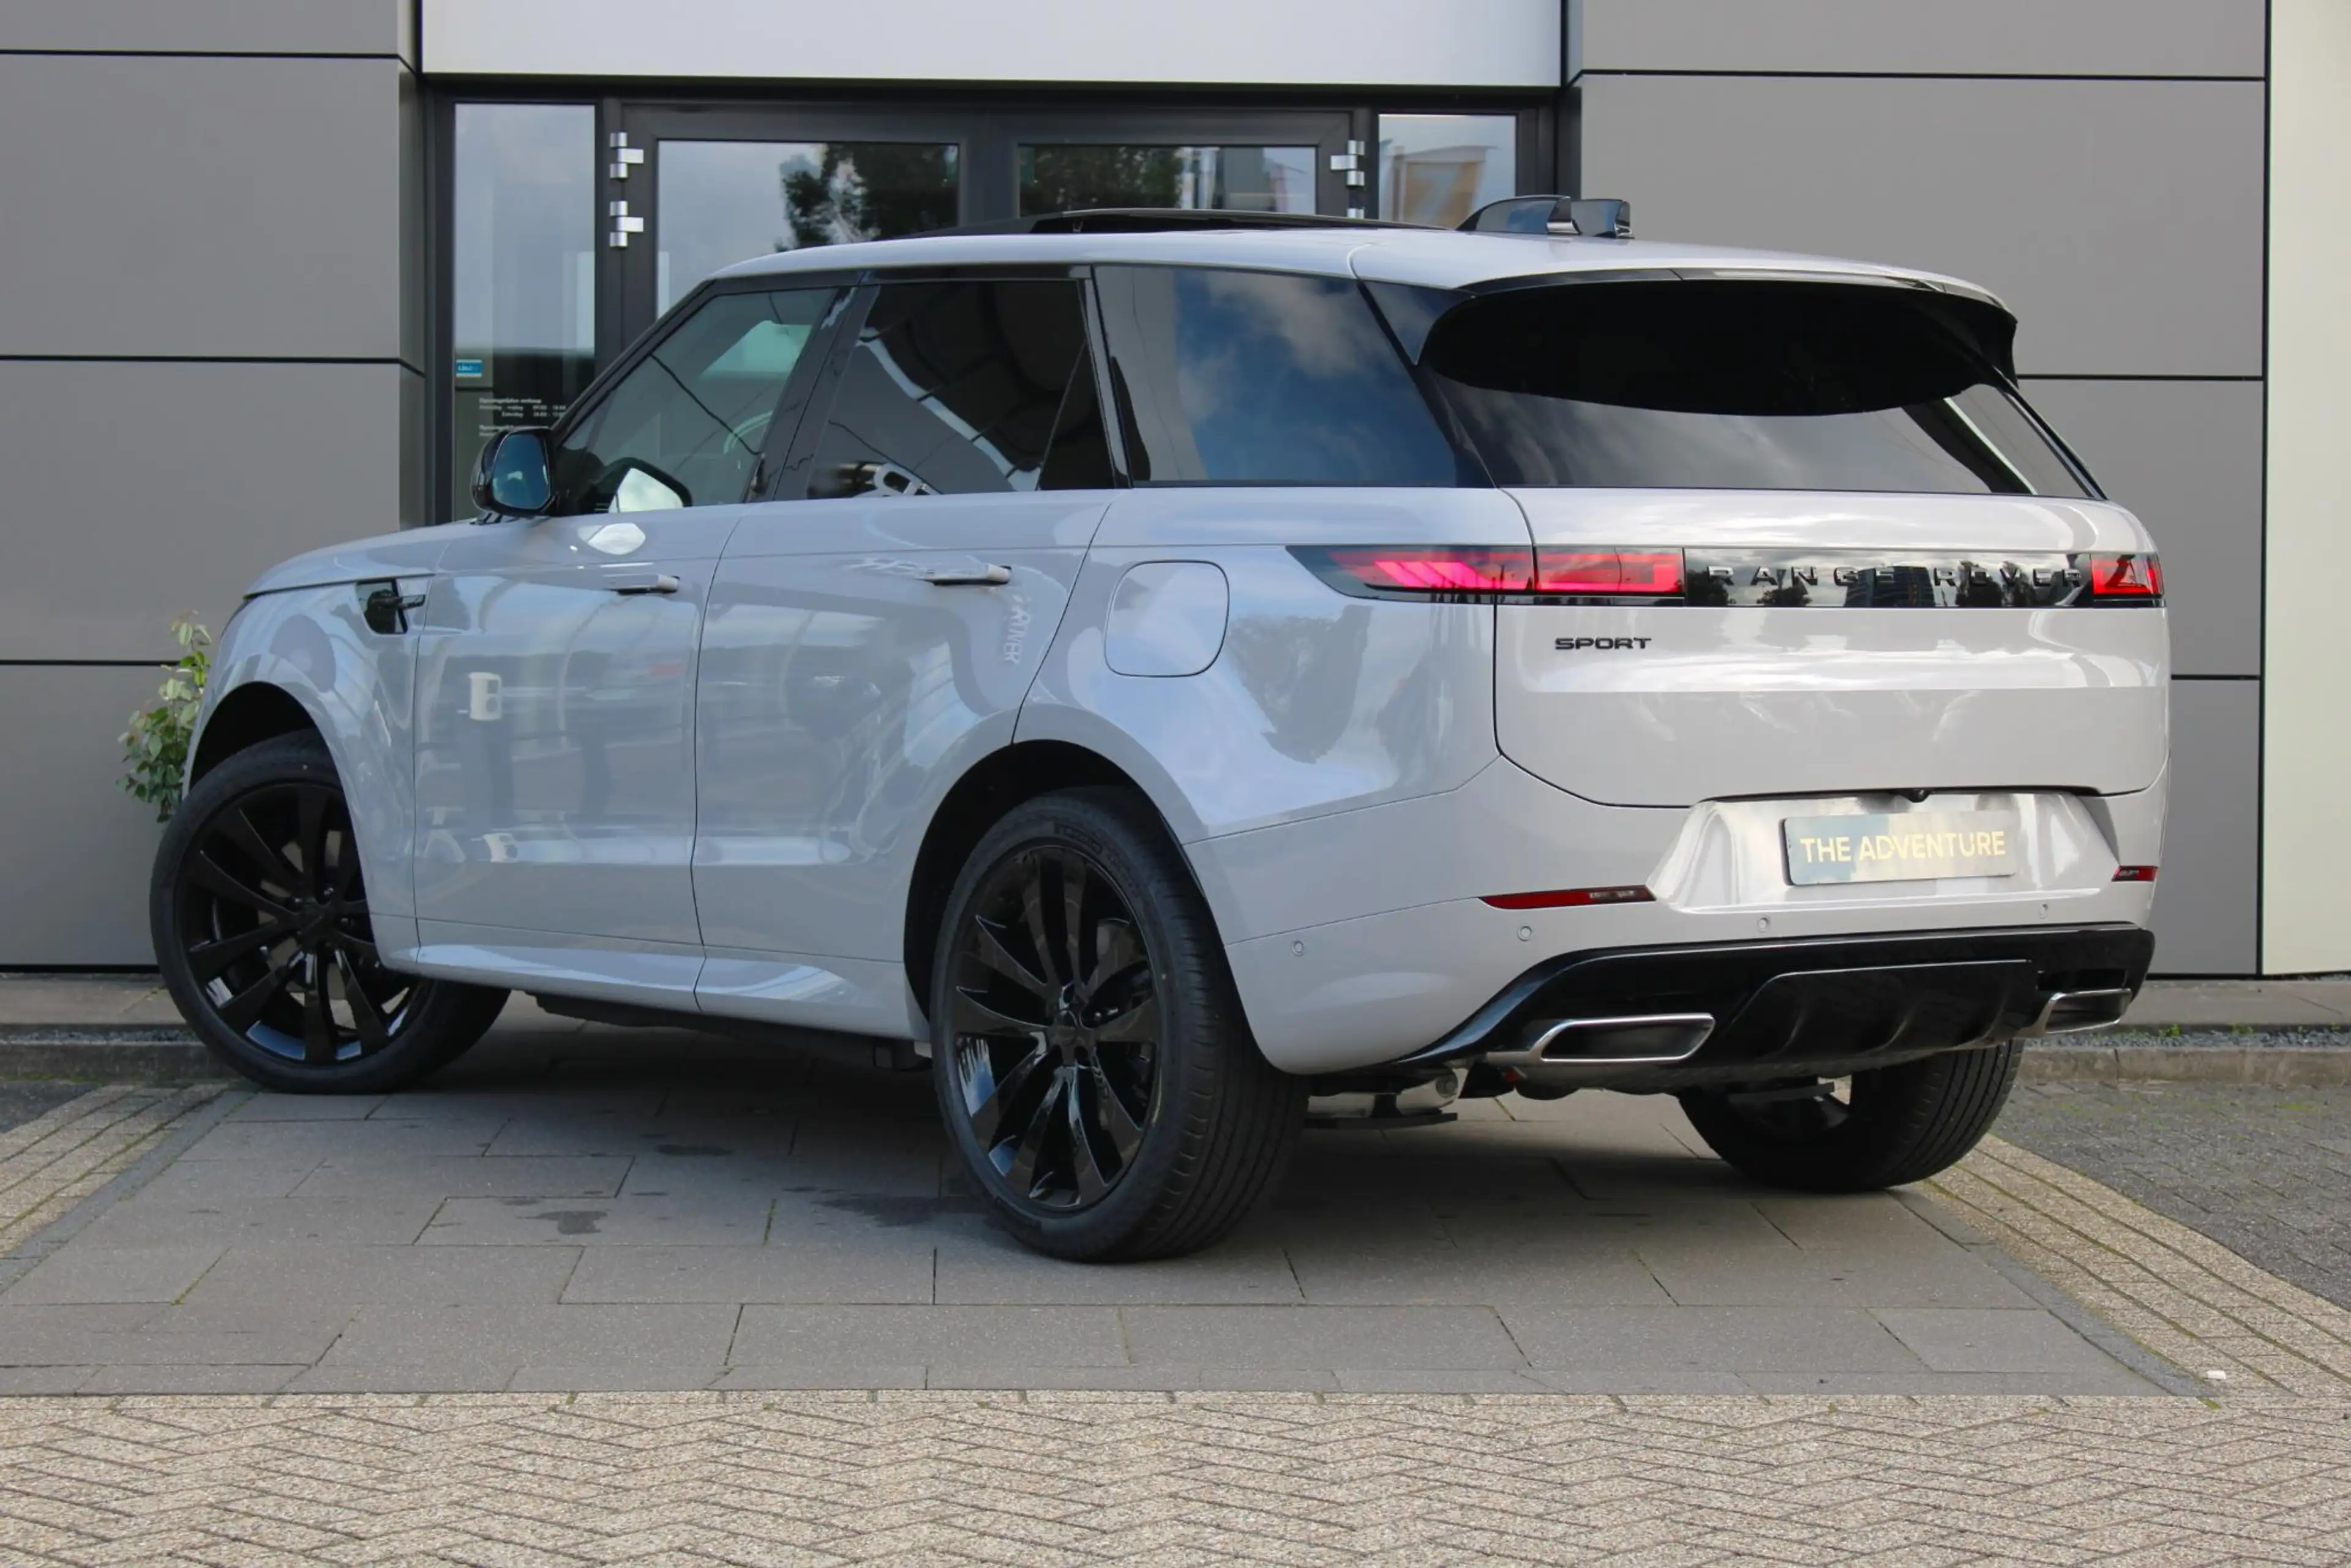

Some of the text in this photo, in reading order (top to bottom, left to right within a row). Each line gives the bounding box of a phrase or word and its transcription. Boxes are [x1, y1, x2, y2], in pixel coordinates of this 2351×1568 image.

[1706, 565, 2081, 587] RANGE ROVER
[1554, 637, 1652, 650] SPORT
[1800, 830, 2006, 863] THE ADVENTURE
